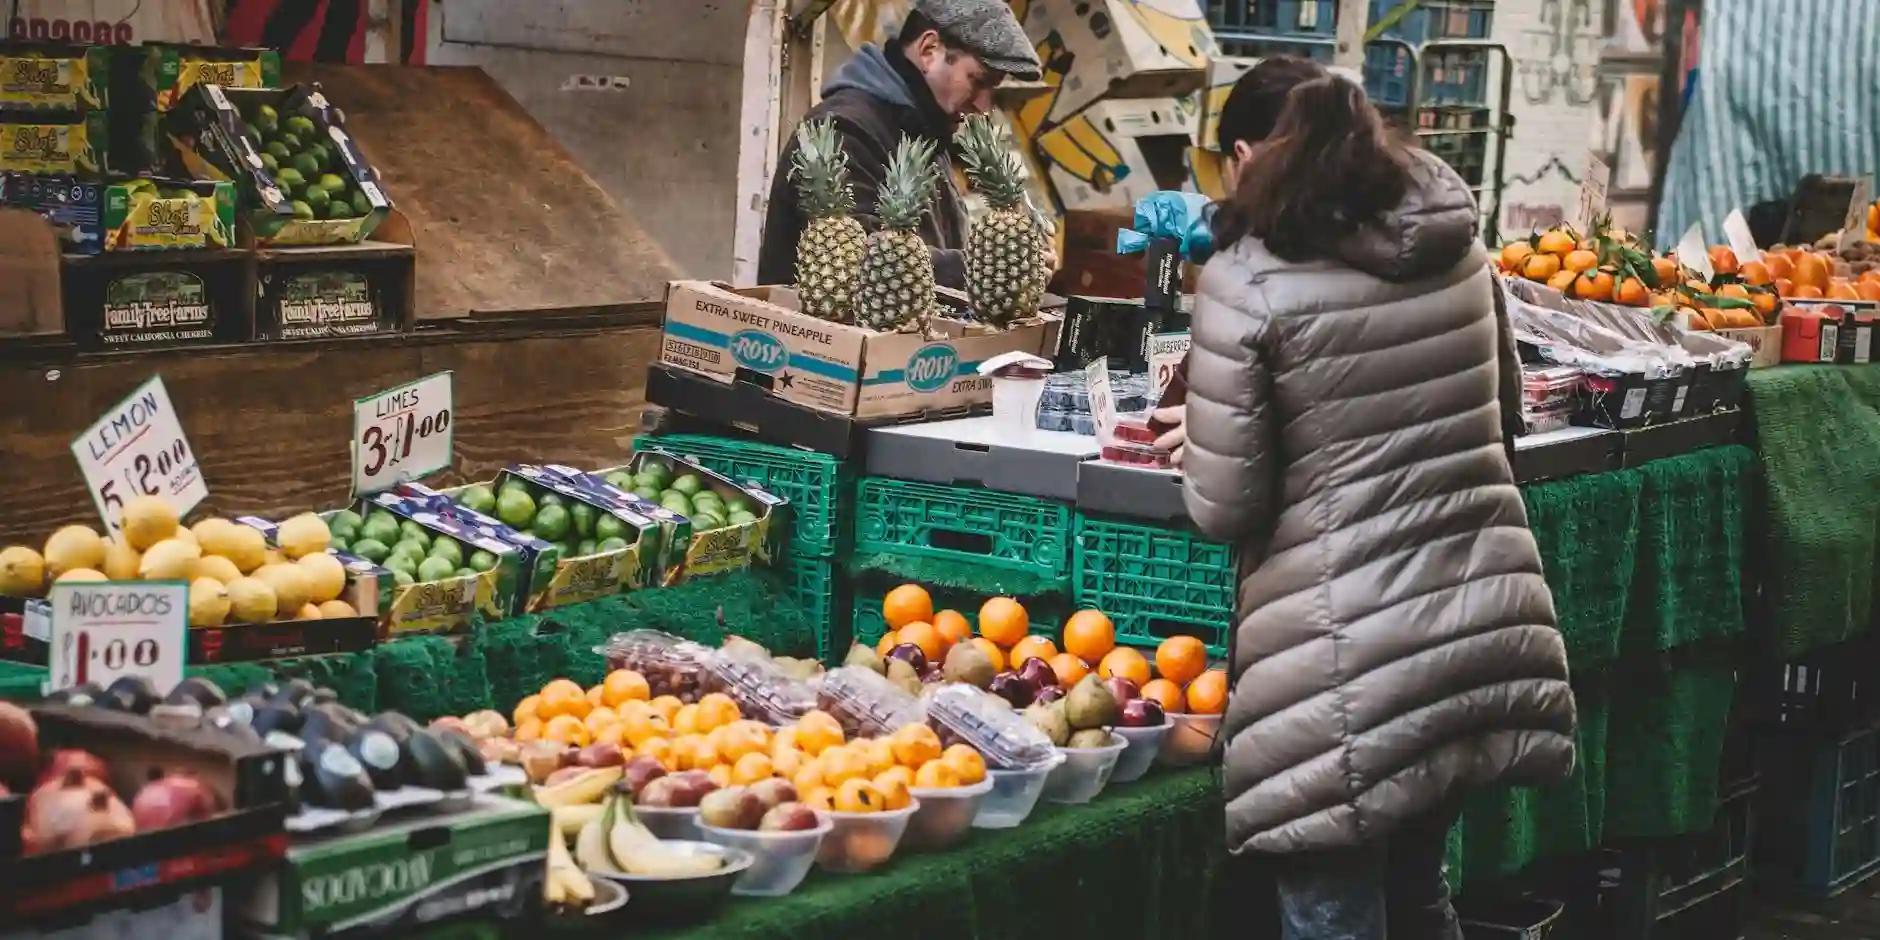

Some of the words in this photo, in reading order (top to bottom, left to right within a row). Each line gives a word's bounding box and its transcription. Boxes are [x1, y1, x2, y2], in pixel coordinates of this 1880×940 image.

[695, 300, 730, 318] EXTRA
[731, 309, 771, 329] SWEET
[772, 318, 833, 346] PINEAPPLE
[735, 336, 782, 364] ROSY
[911, 355, 954, 381] ROSY
[376, 389, 419, 418] LIMES
[952, 379, 976, 393] EXTRA
[88, 392, 157, 460] LEMON
[363, 426, 387, 476] 3
[99, 480, 123, 530] 5
[70, 591, 172, 617] AVOCADOS
[61, 629, 160, 687] £1.00
